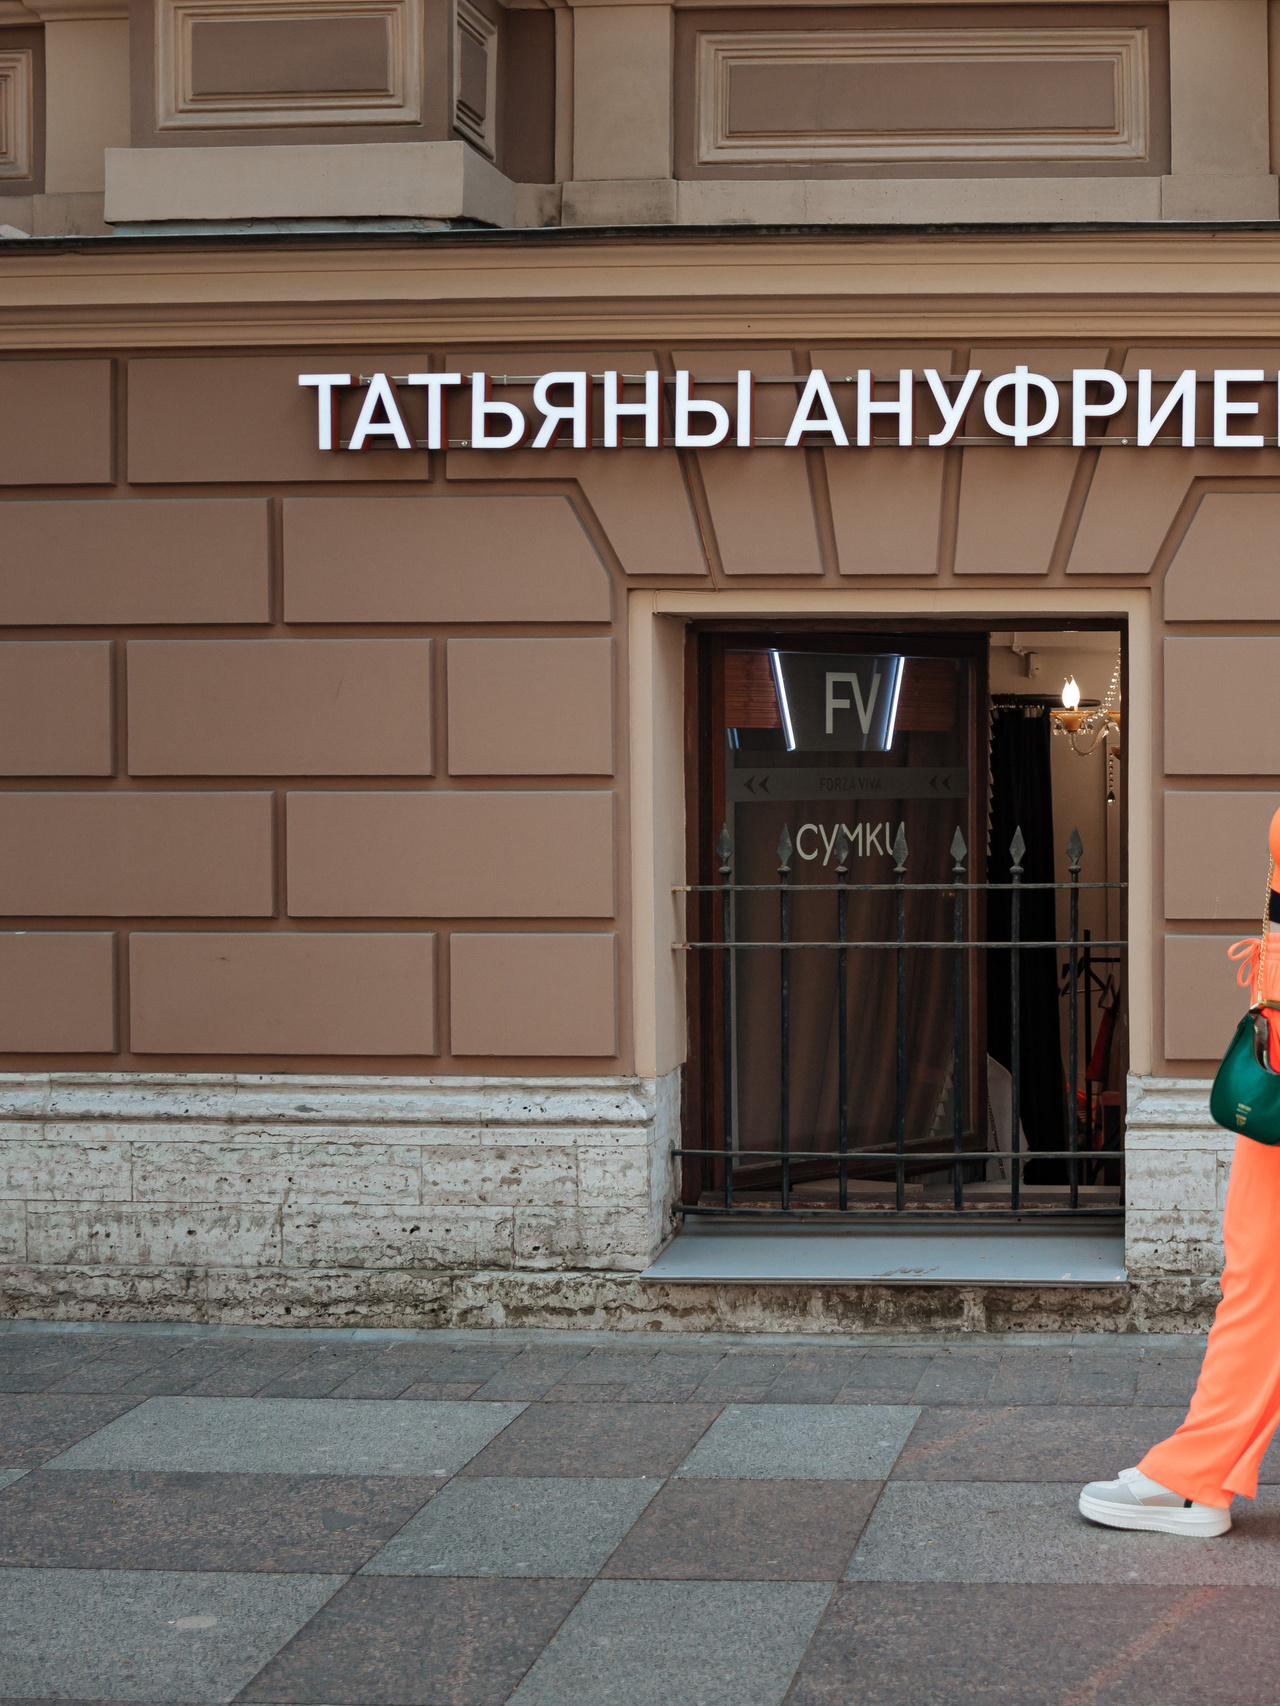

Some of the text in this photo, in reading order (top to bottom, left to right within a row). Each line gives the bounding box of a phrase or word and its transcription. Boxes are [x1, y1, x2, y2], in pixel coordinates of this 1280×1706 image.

[299, 370, 752, 450] ТАТЬЯНЫ
[825, 672, 881, 735] FV
[820, 777, 882, 791] FORZA VIVA
